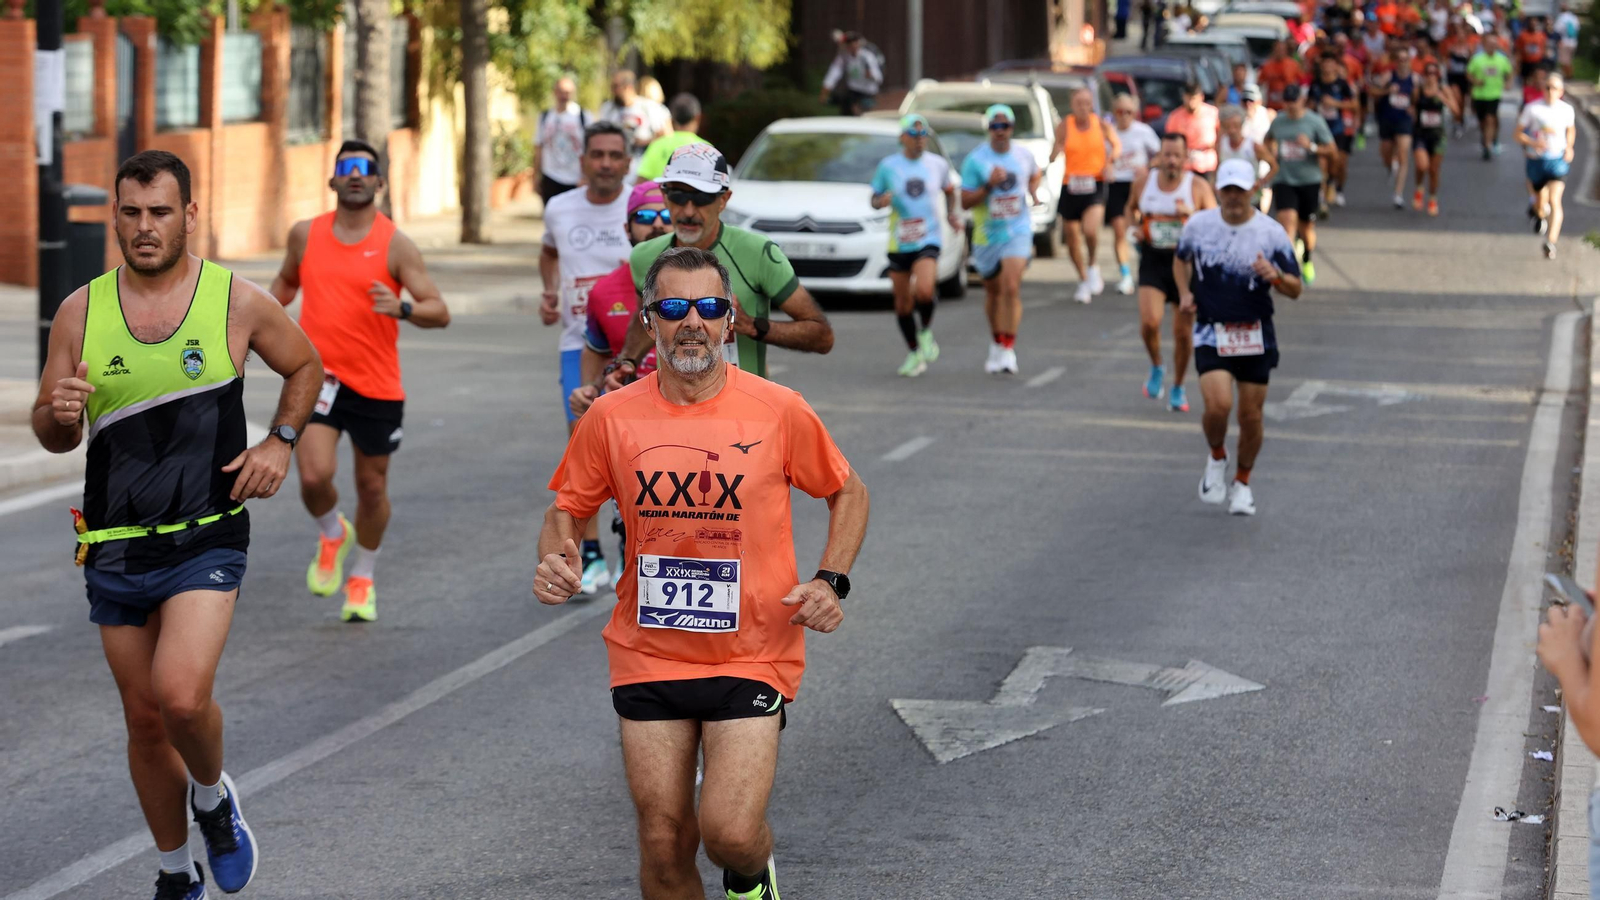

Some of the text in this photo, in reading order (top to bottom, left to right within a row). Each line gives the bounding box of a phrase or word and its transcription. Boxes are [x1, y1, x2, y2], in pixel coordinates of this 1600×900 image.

[671, 510, 725, 520] MARATÓN
[725, 513, 741, 521] DE
[208, 573, 224, 583] ipso
[662, 582, 713, 607] 912
[752, 699, 768, 708] ipso
